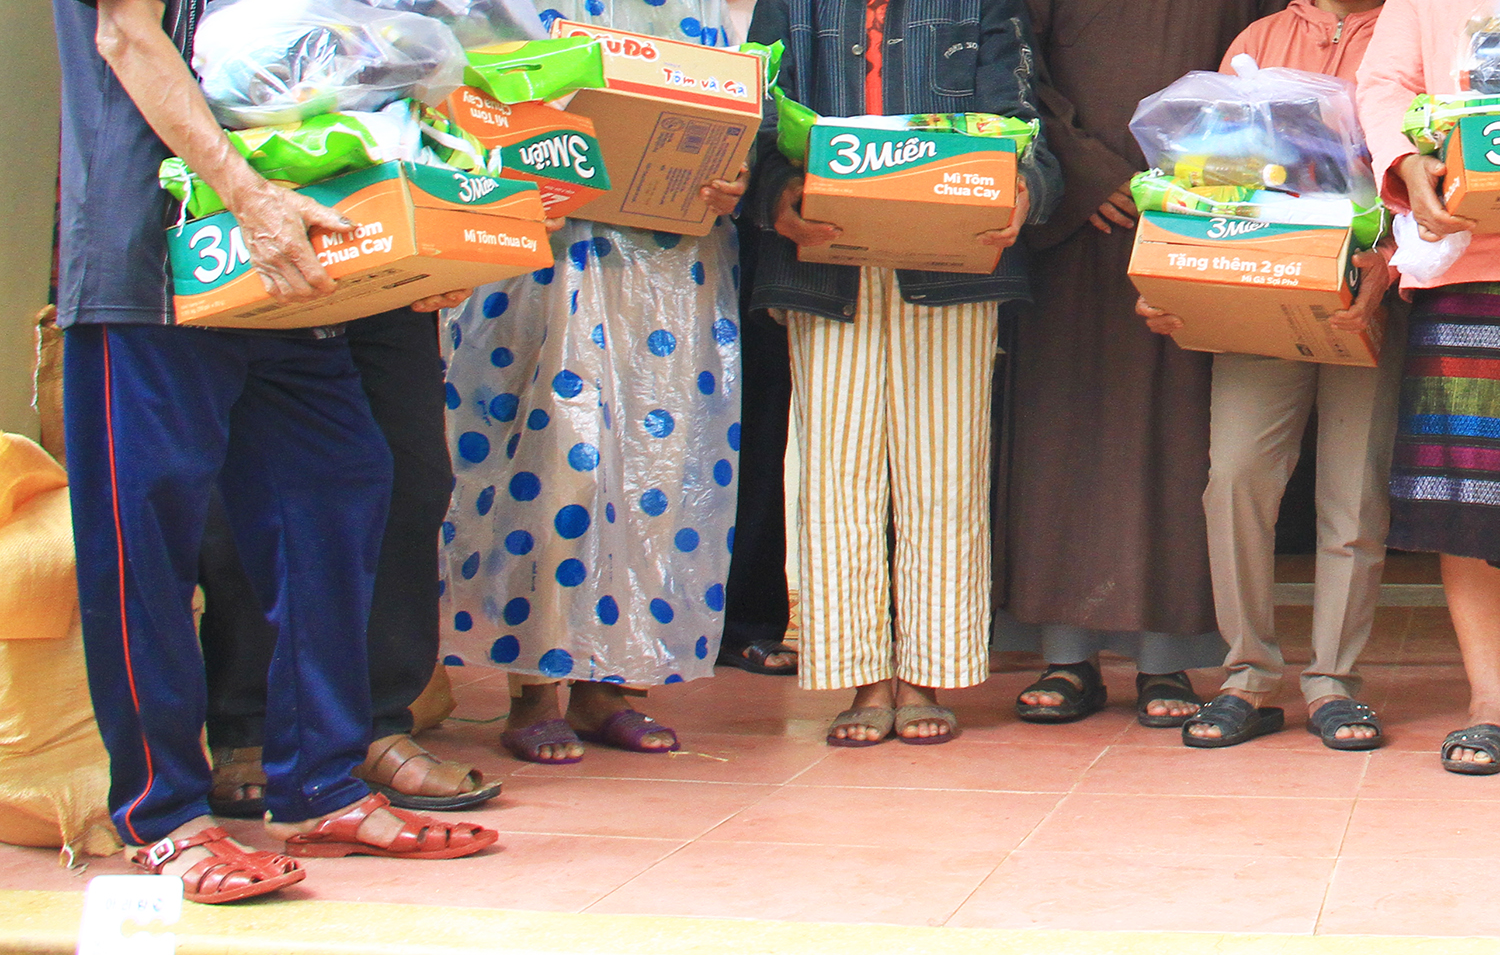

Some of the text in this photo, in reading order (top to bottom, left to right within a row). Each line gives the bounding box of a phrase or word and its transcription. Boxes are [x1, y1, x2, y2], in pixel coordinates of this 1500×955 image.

[663, 68, 696, 86] Tôm
[943, 173, 994, 186] Mì Tôm
[934, 184, 1000, 200] Chua Cay
[361, 235, 393, 259] Cay
[477, 230, 497, 245] Tôm
[498, 232, 520, 248] Chua
[521, 236, 537, 252] Cay
[1168, 253, 1302, 278] Tặng thêm 2 gói
